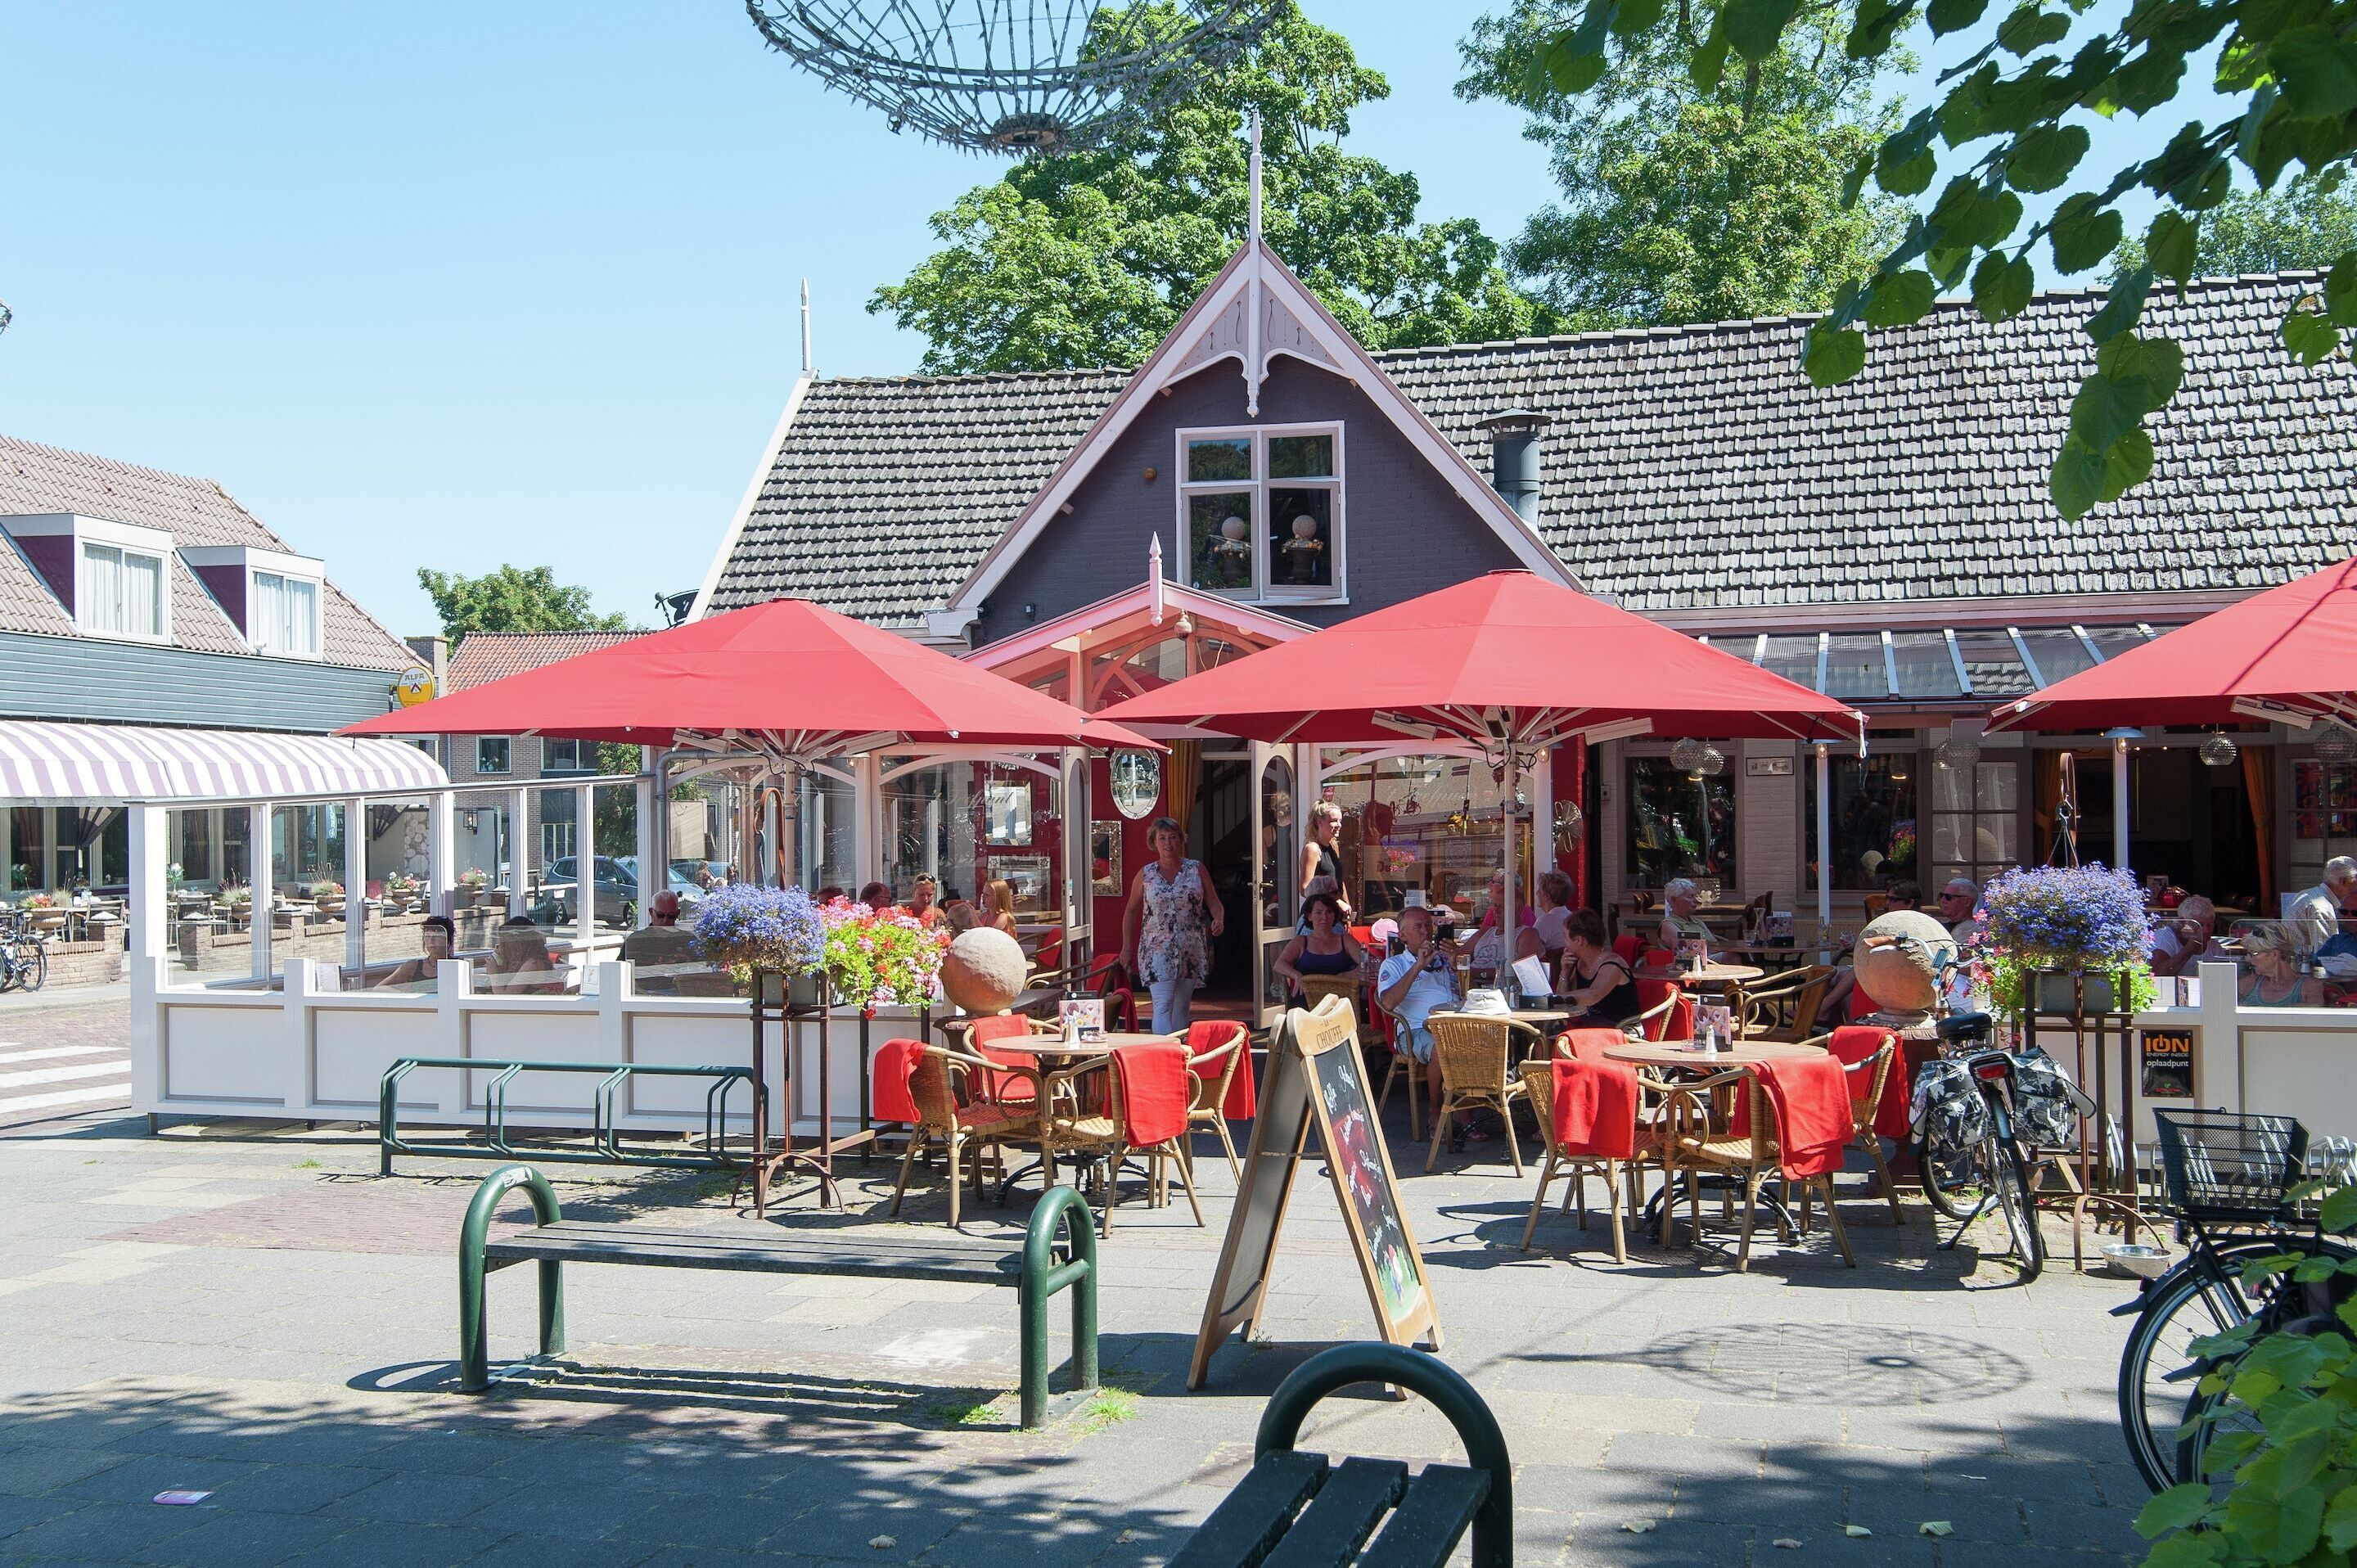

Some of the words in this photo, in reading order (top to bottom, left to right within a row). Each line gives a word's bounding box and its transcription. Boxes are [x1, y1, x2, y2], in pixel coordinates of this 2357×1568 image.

[404, 673, 425, 681] ALFA
[1316, 1025, 1345, 1049] CHOUFFE
[2145, 1034, 2189, 1052] ION
[2146, 1059, 2189, 1069] oplaadpunt
